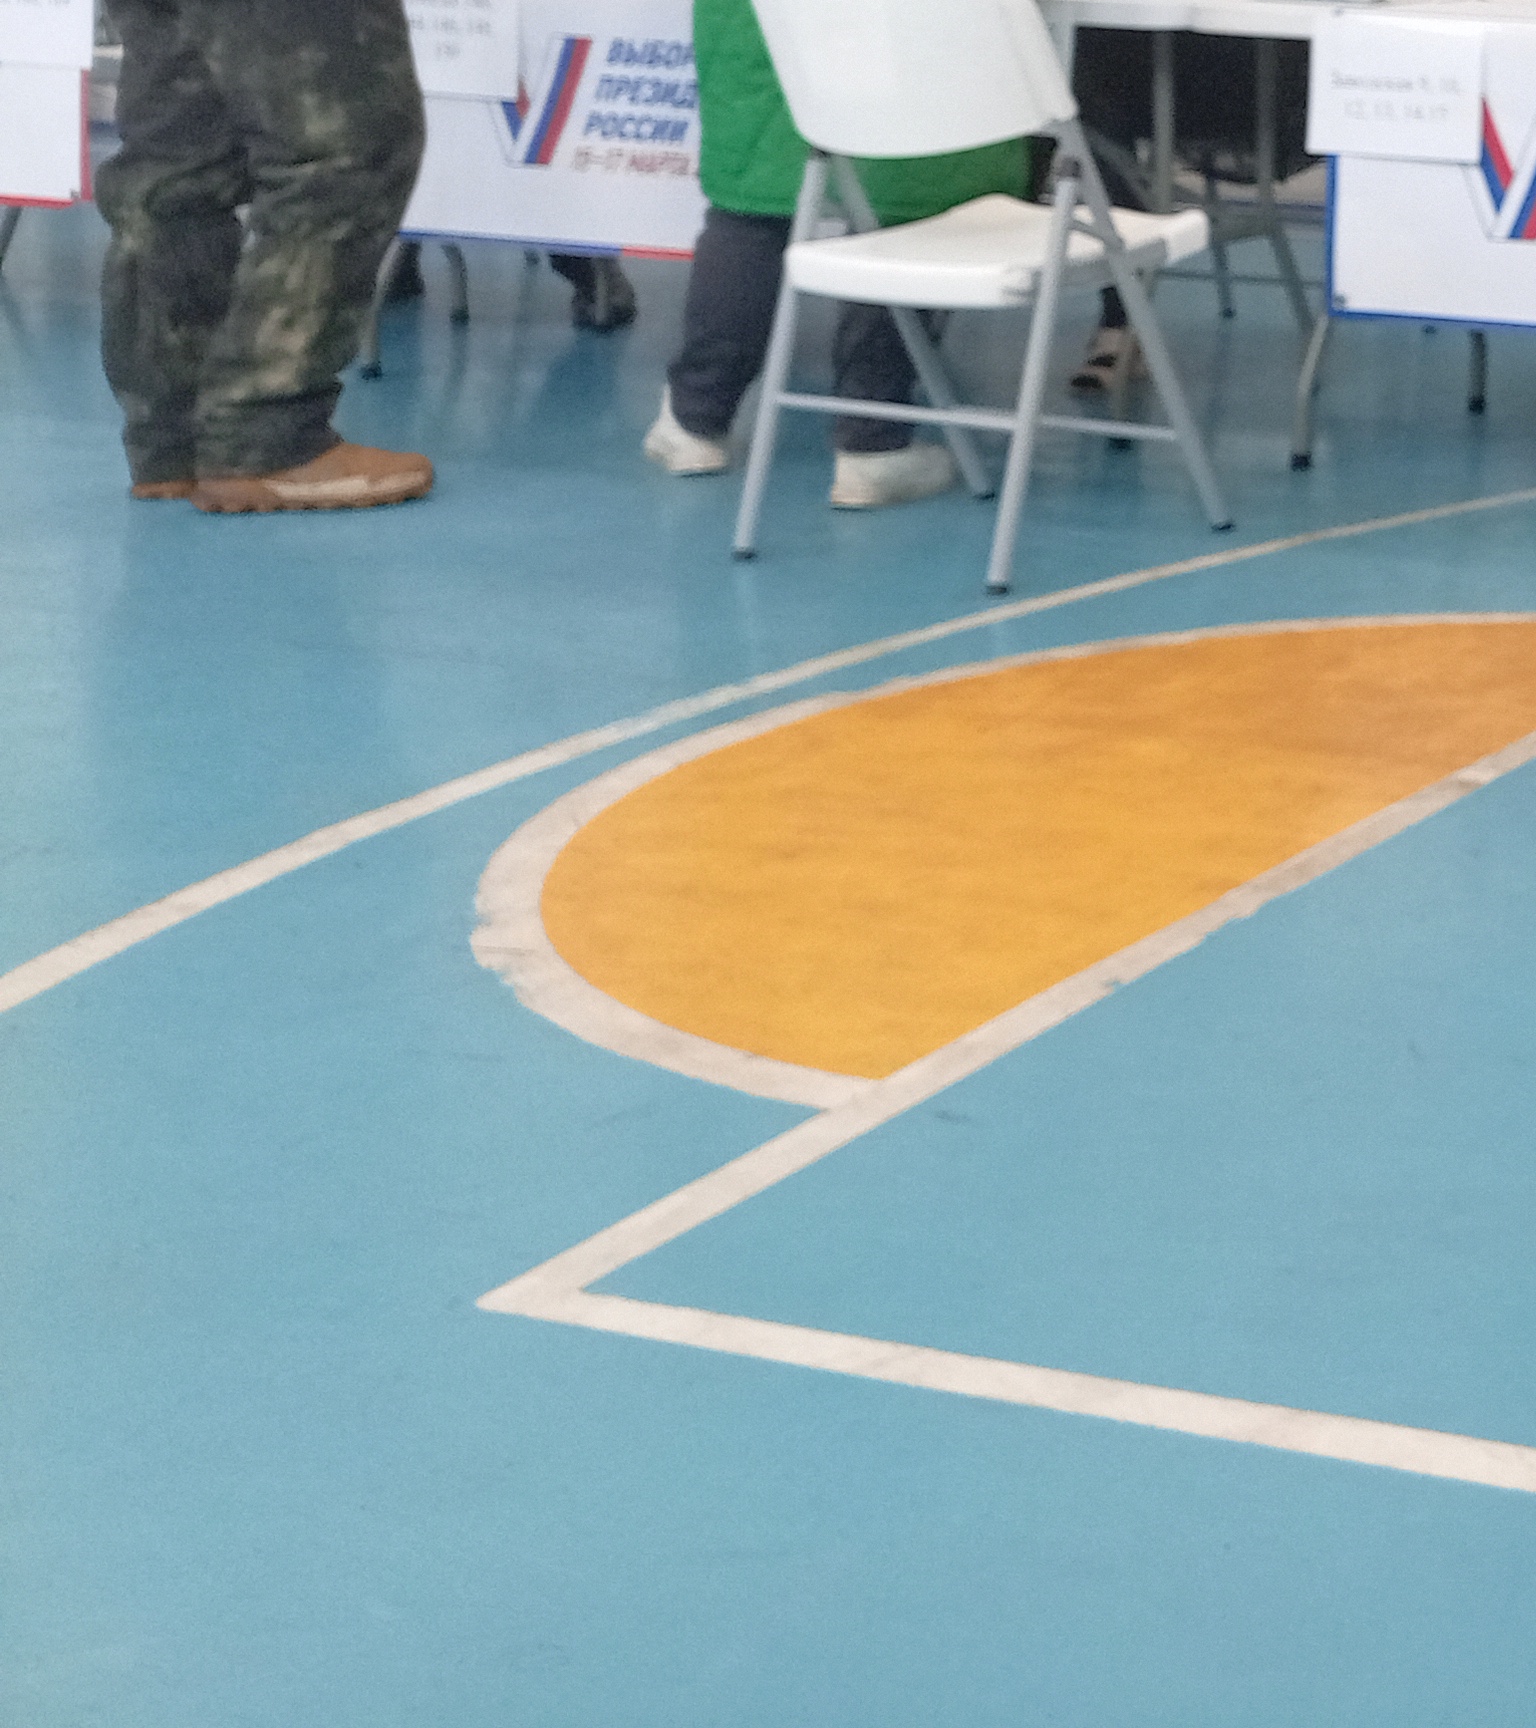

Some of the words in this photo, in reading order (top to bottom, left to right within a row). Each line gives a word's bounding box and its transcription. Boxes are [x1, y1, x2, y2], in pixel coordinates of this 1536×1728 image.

[607, 37, 696, 67] ВЫБОР
[595, 73, 699, 109] ПРЕЗИД
[583, 110, 689, 143] РОССИИ
